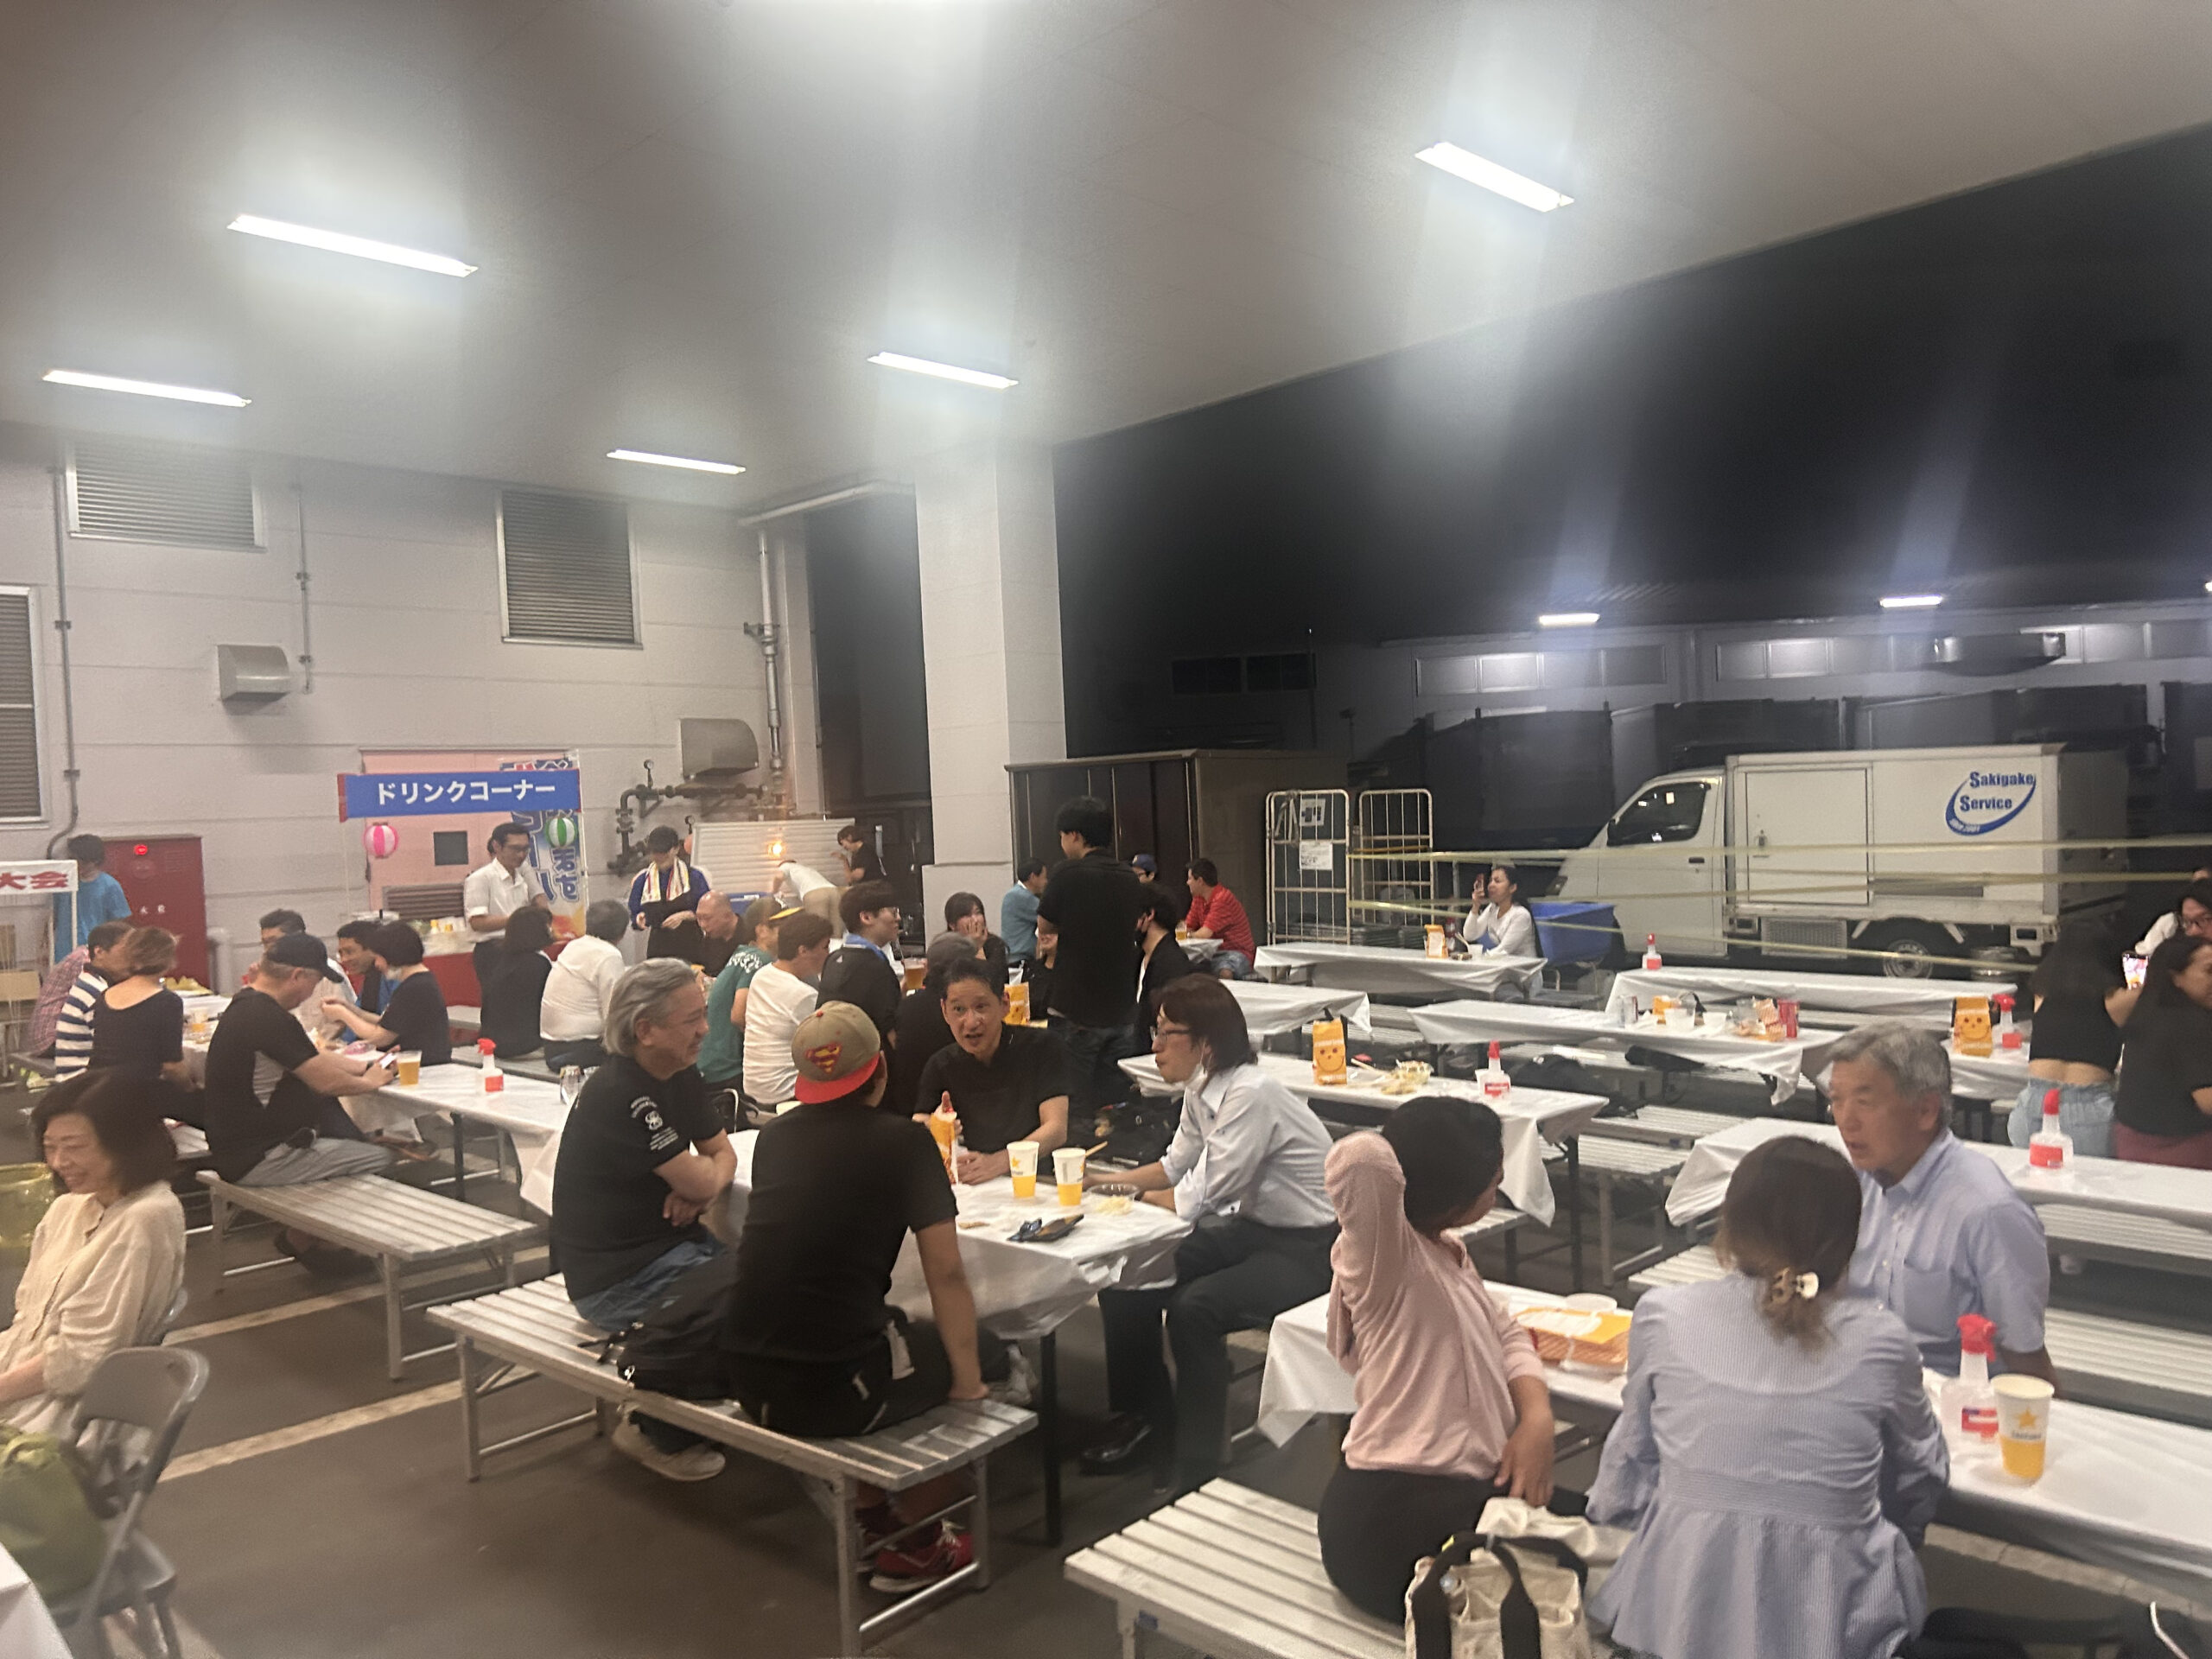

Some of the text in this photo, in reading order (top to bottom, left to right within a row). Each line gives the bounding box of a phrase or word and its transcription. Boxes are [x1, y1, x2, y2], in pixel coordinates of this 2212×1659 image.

[1969, 772, 2033, 788] Sakigake
[378, 779, 556, 805] ドリンクコーナー
[1960, 795, 2012, 811] Service
[0, 871, 68, 890] 大会
